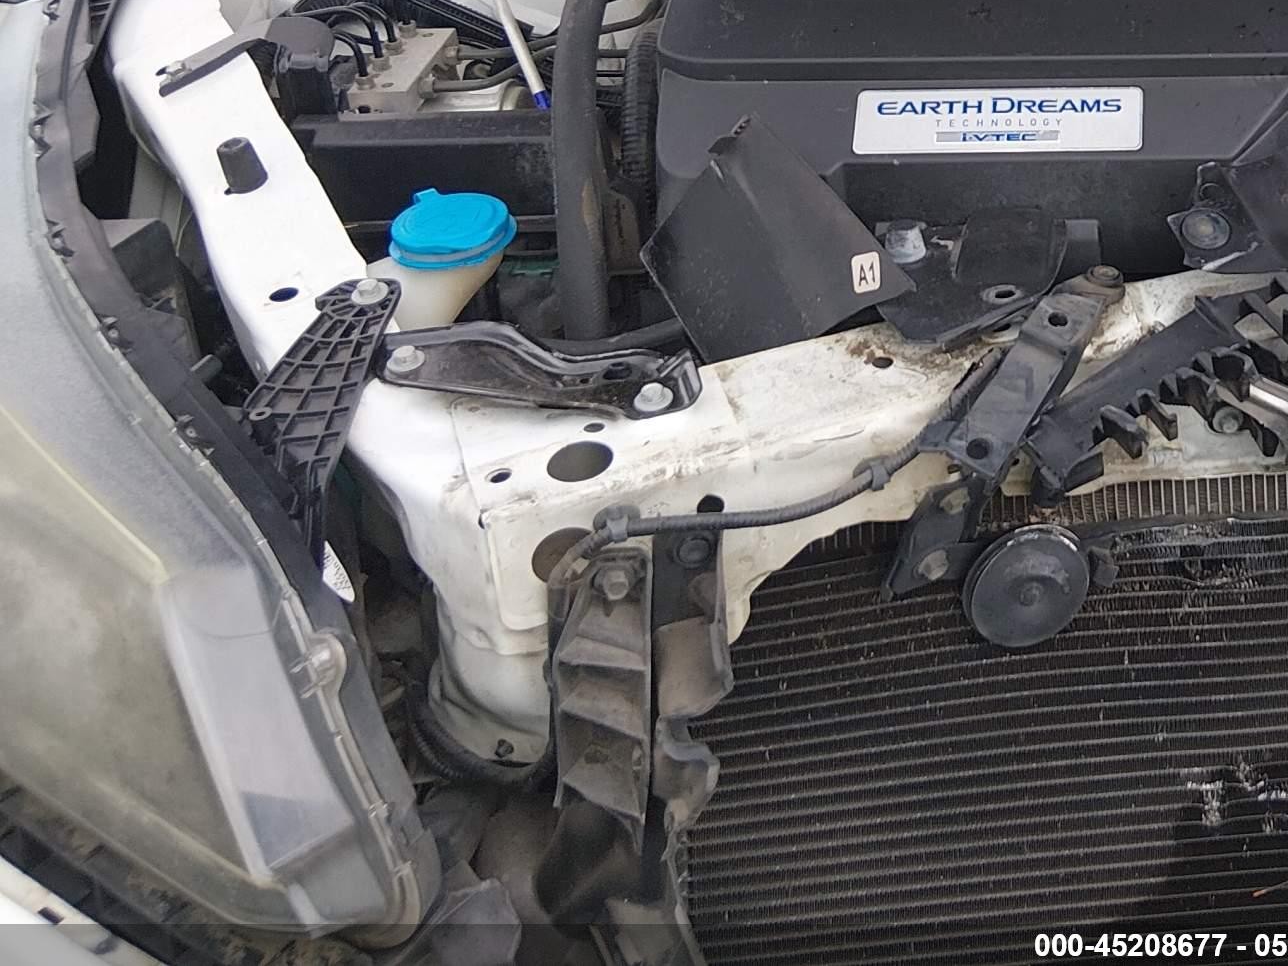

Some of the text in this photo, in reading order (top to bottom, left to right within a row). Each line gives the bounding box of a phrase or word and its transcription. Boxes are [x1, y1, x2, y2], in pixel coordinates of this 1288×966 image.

[877, 97, 1122, 115] EARTH DREAMS
[934, 117, 1064, 128] TECHNOLOGY
[858, 261, 877, 287] A1
